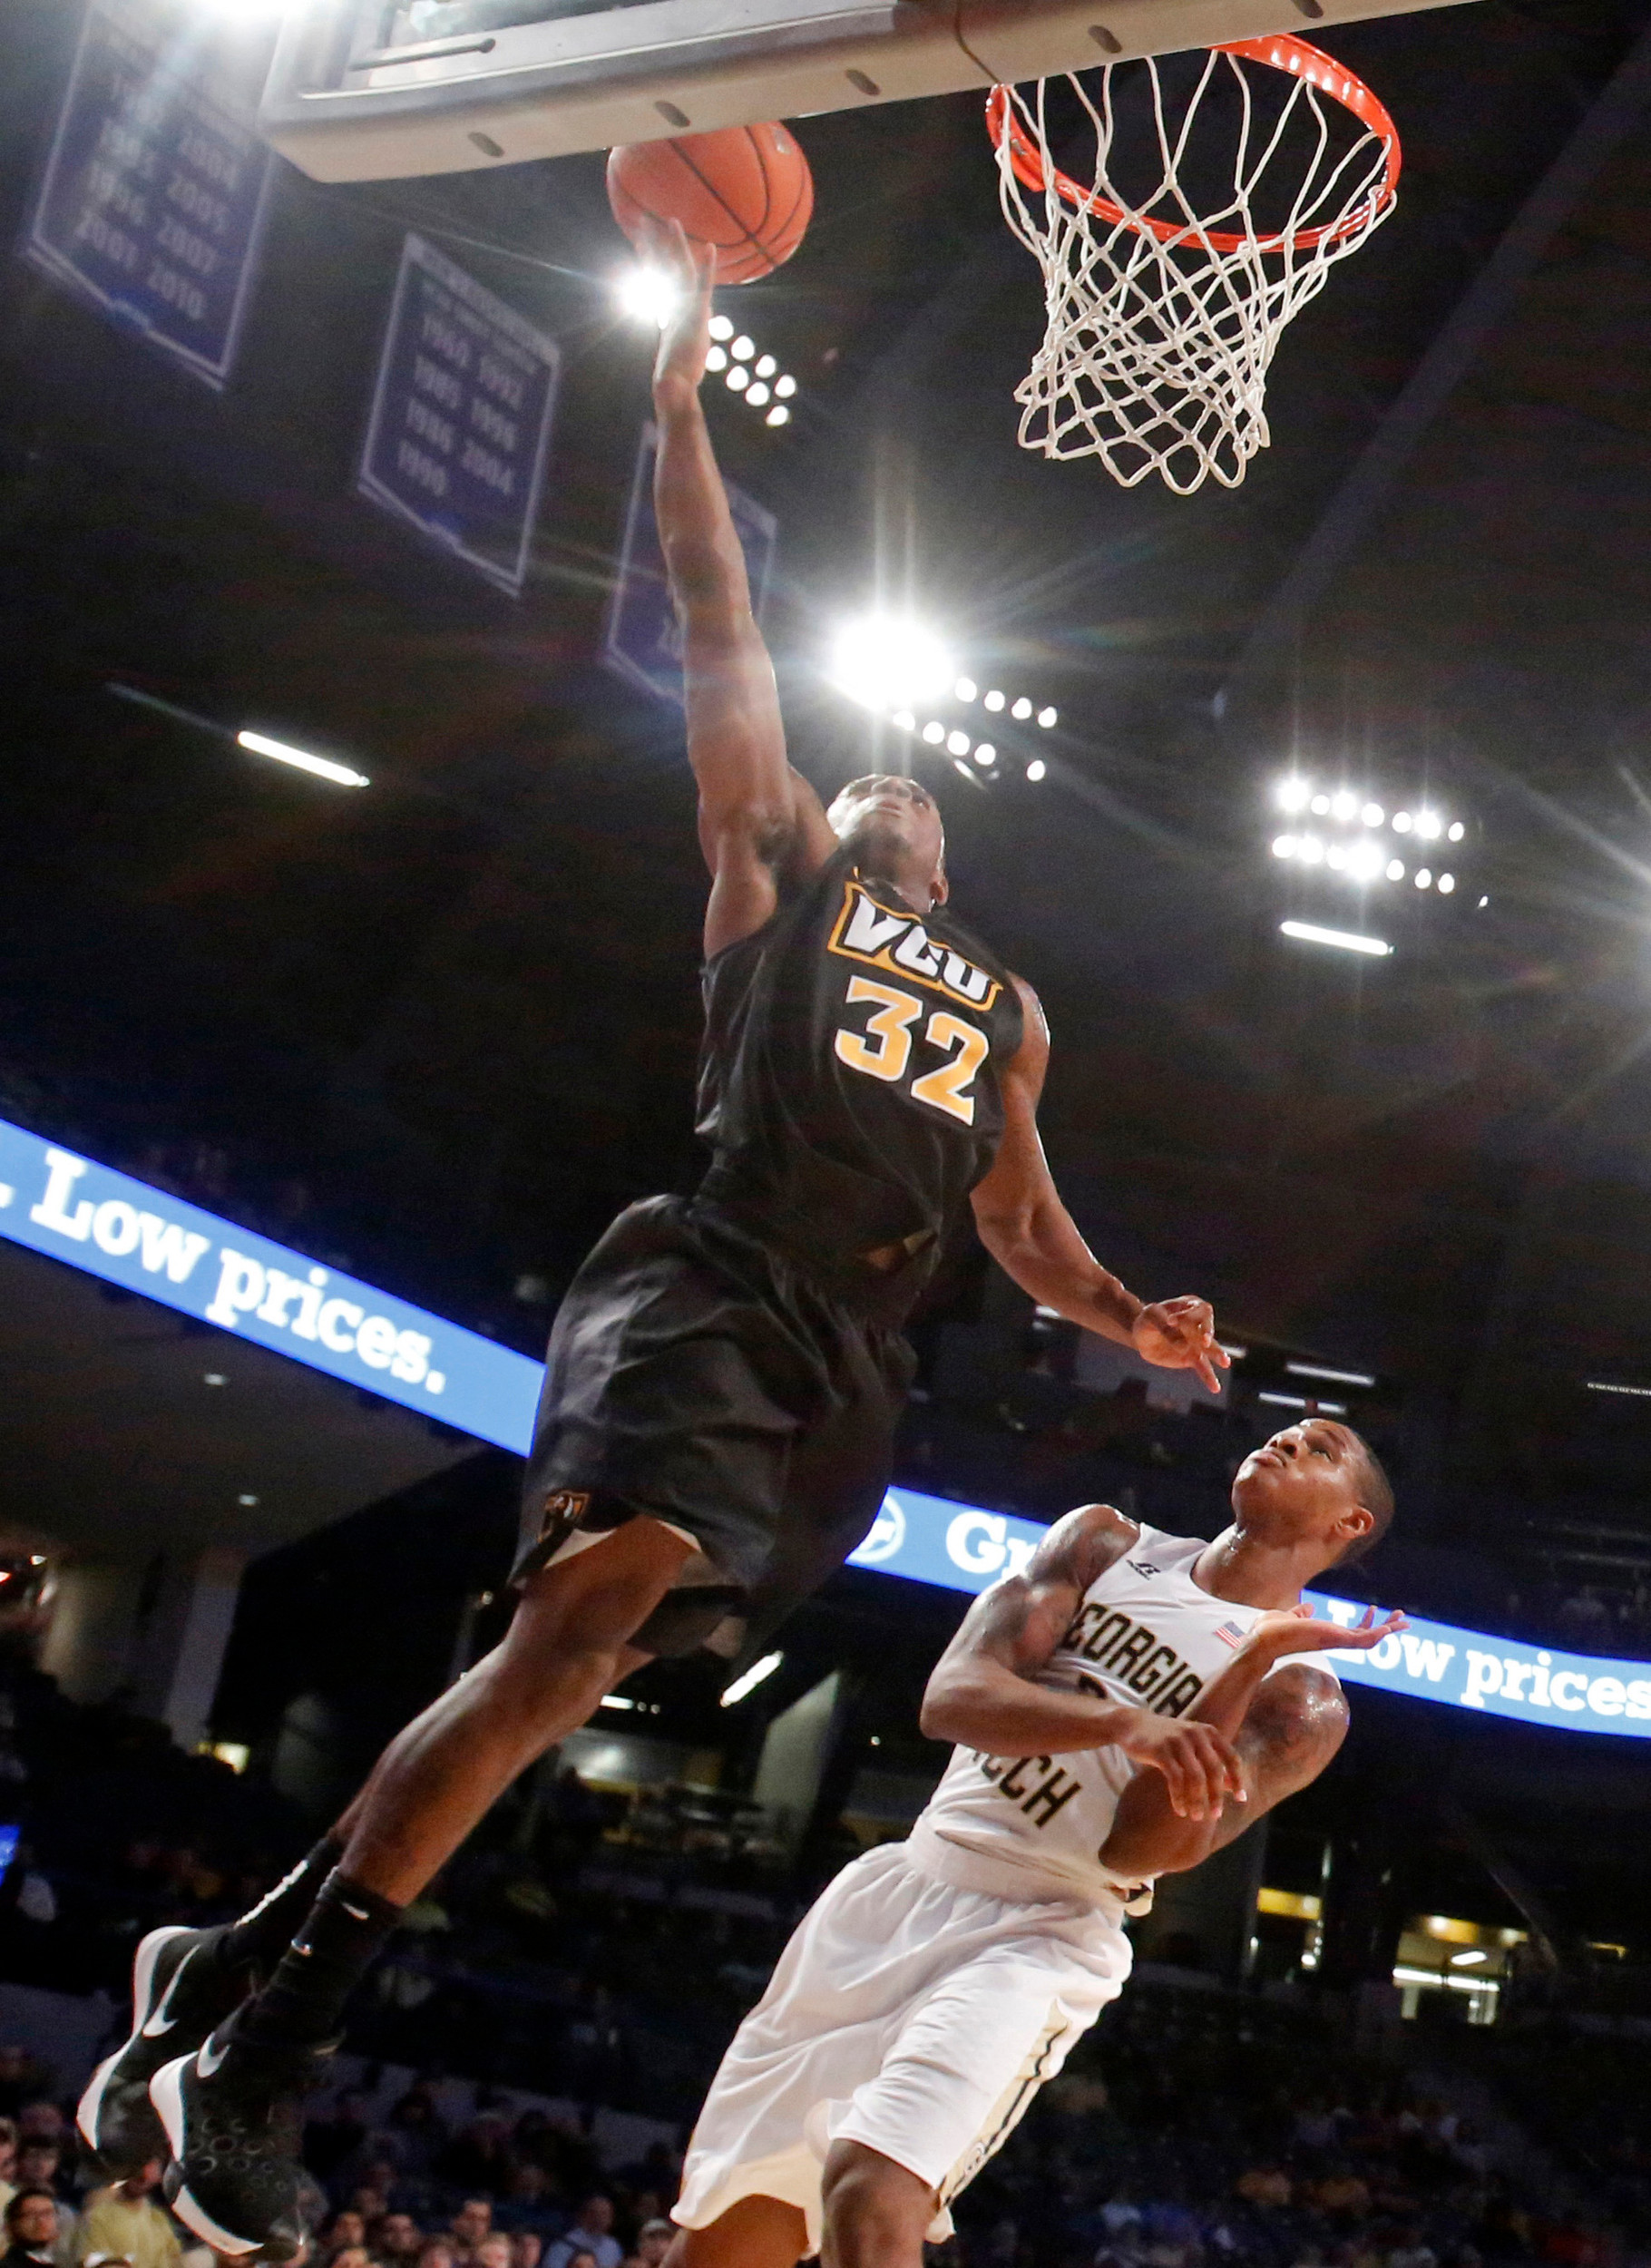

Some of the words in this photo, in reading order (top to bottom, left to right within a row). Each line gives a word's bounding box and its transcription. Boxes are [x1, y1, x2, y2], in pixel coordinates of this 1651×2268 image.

[840, 891, 992, 1003] VCU
[834, 974, 991, 1127] 32
[30, 1148, 209, 1284] Low
[205, 1246, 447, 1395] prices.
